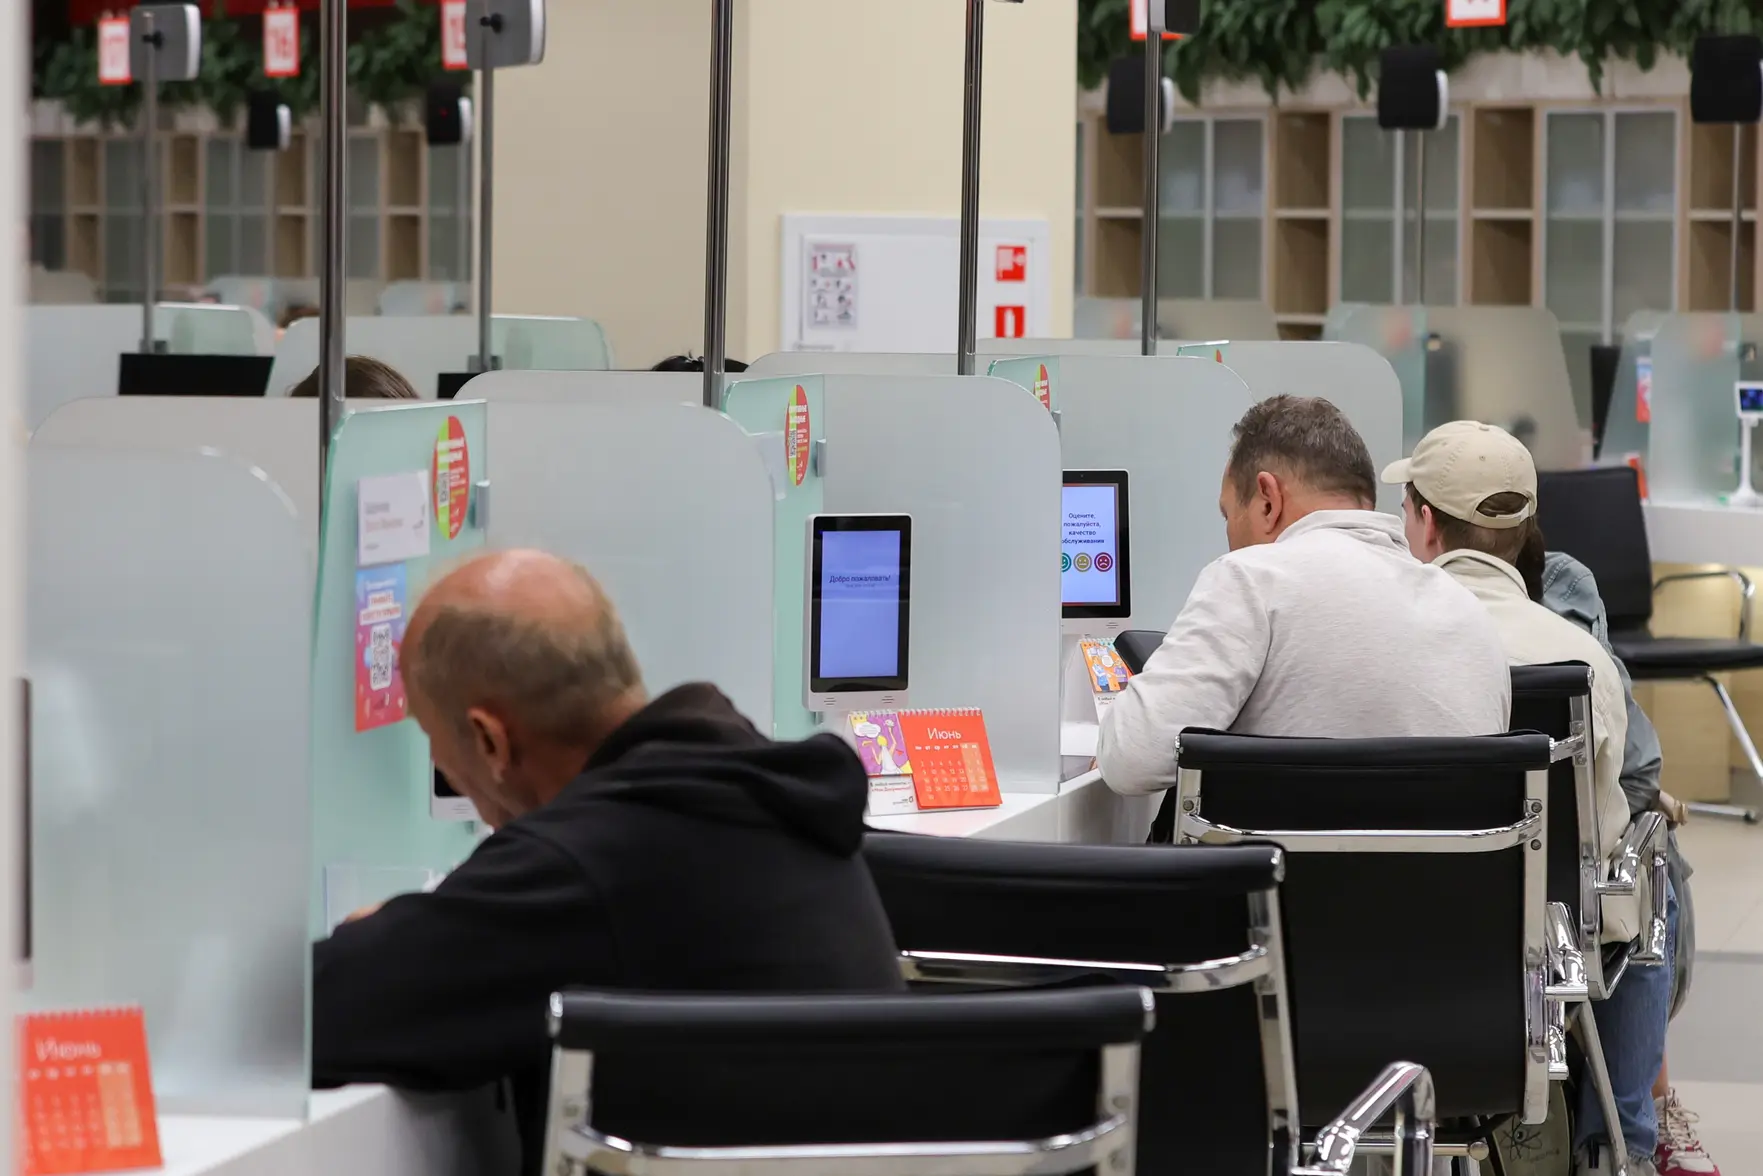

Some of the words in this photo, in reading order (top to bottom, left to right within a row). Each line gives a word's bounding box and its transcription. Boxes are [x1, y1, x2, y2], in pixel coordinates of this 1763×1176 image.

[829, 575, 850, 583] Добро
[927, 727, 962, 740] Июнь
[35, 1036, 102, 1062] Июнь
